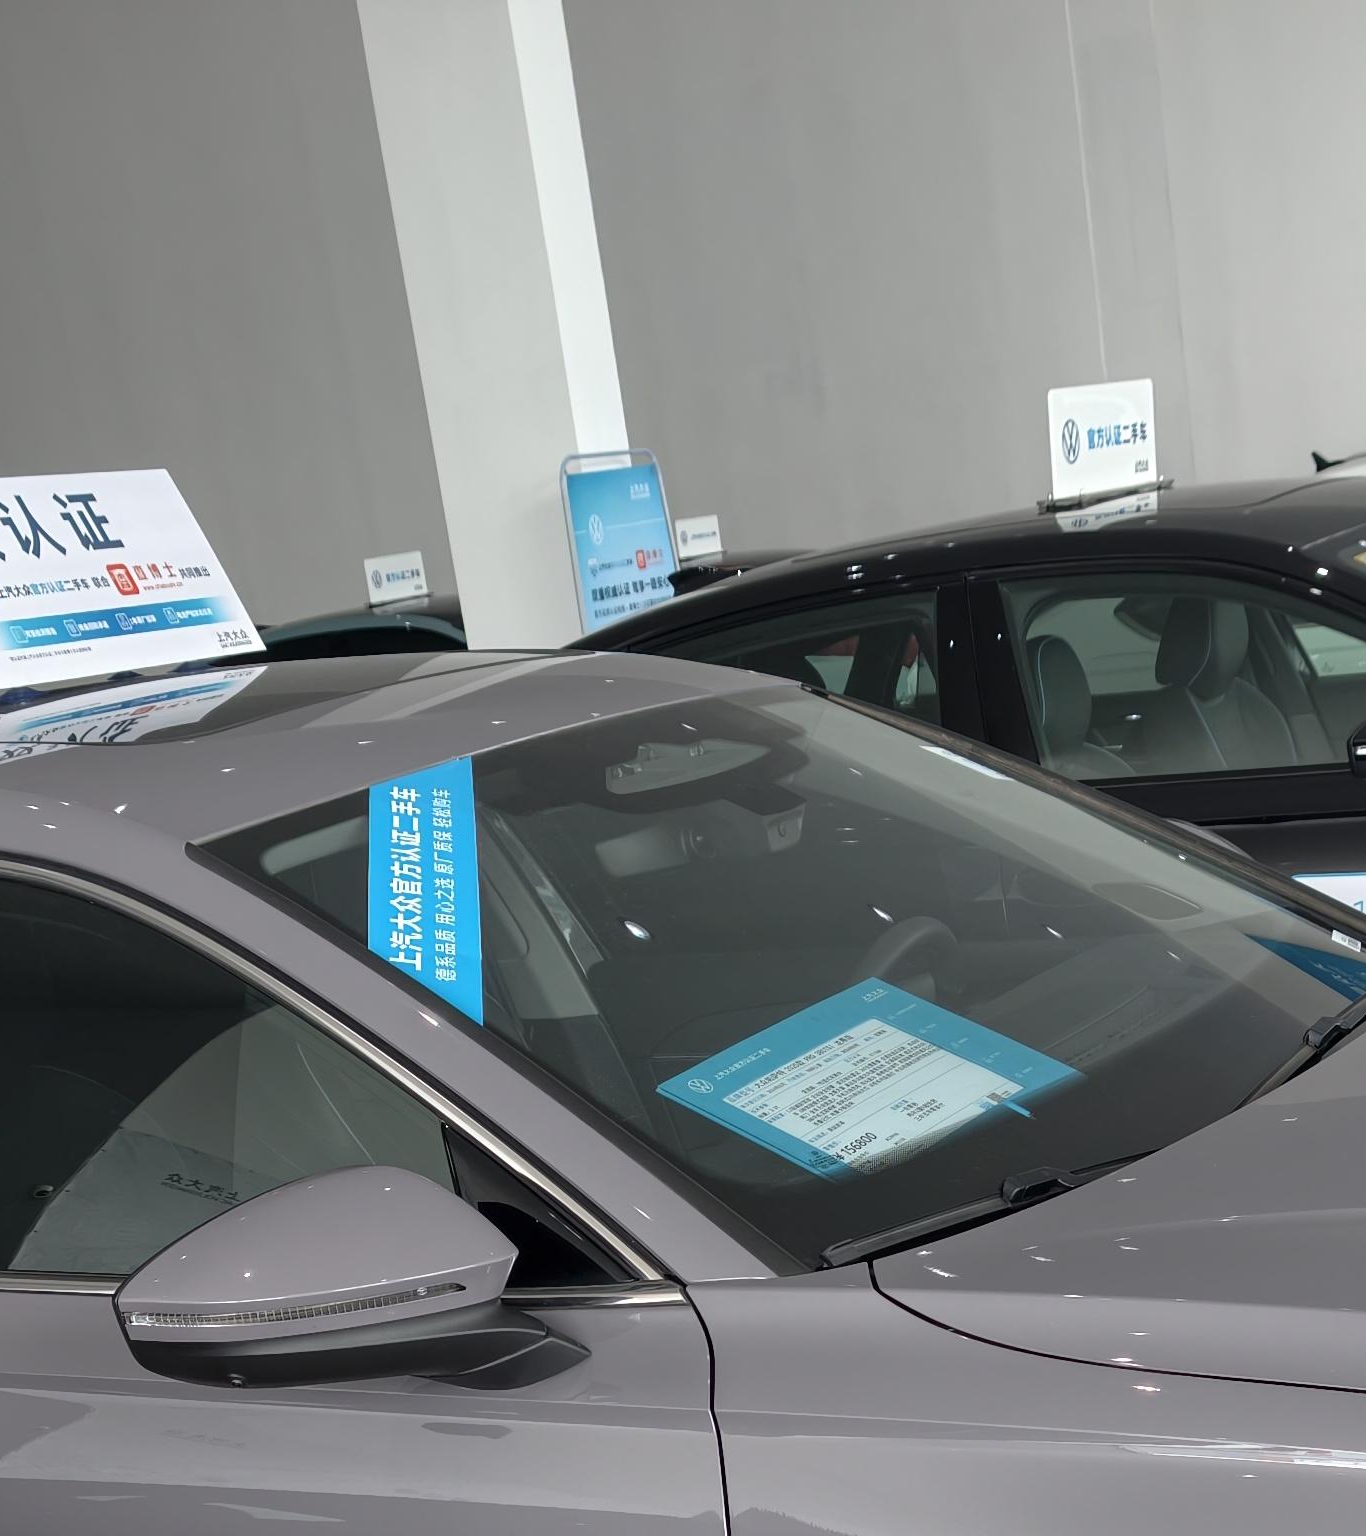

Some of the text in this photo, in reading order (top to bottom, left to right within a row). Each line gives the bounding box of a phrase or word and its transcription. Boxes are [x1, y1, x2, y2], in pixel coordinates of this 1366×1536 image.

[433, 830, 454, 875] 原厂质保
[388, 786, 423, 972] 上汽大众官方认证二手车
[434, 878, 455, 927] 用心之选
[435, 929, 457, 981] 德系品质
